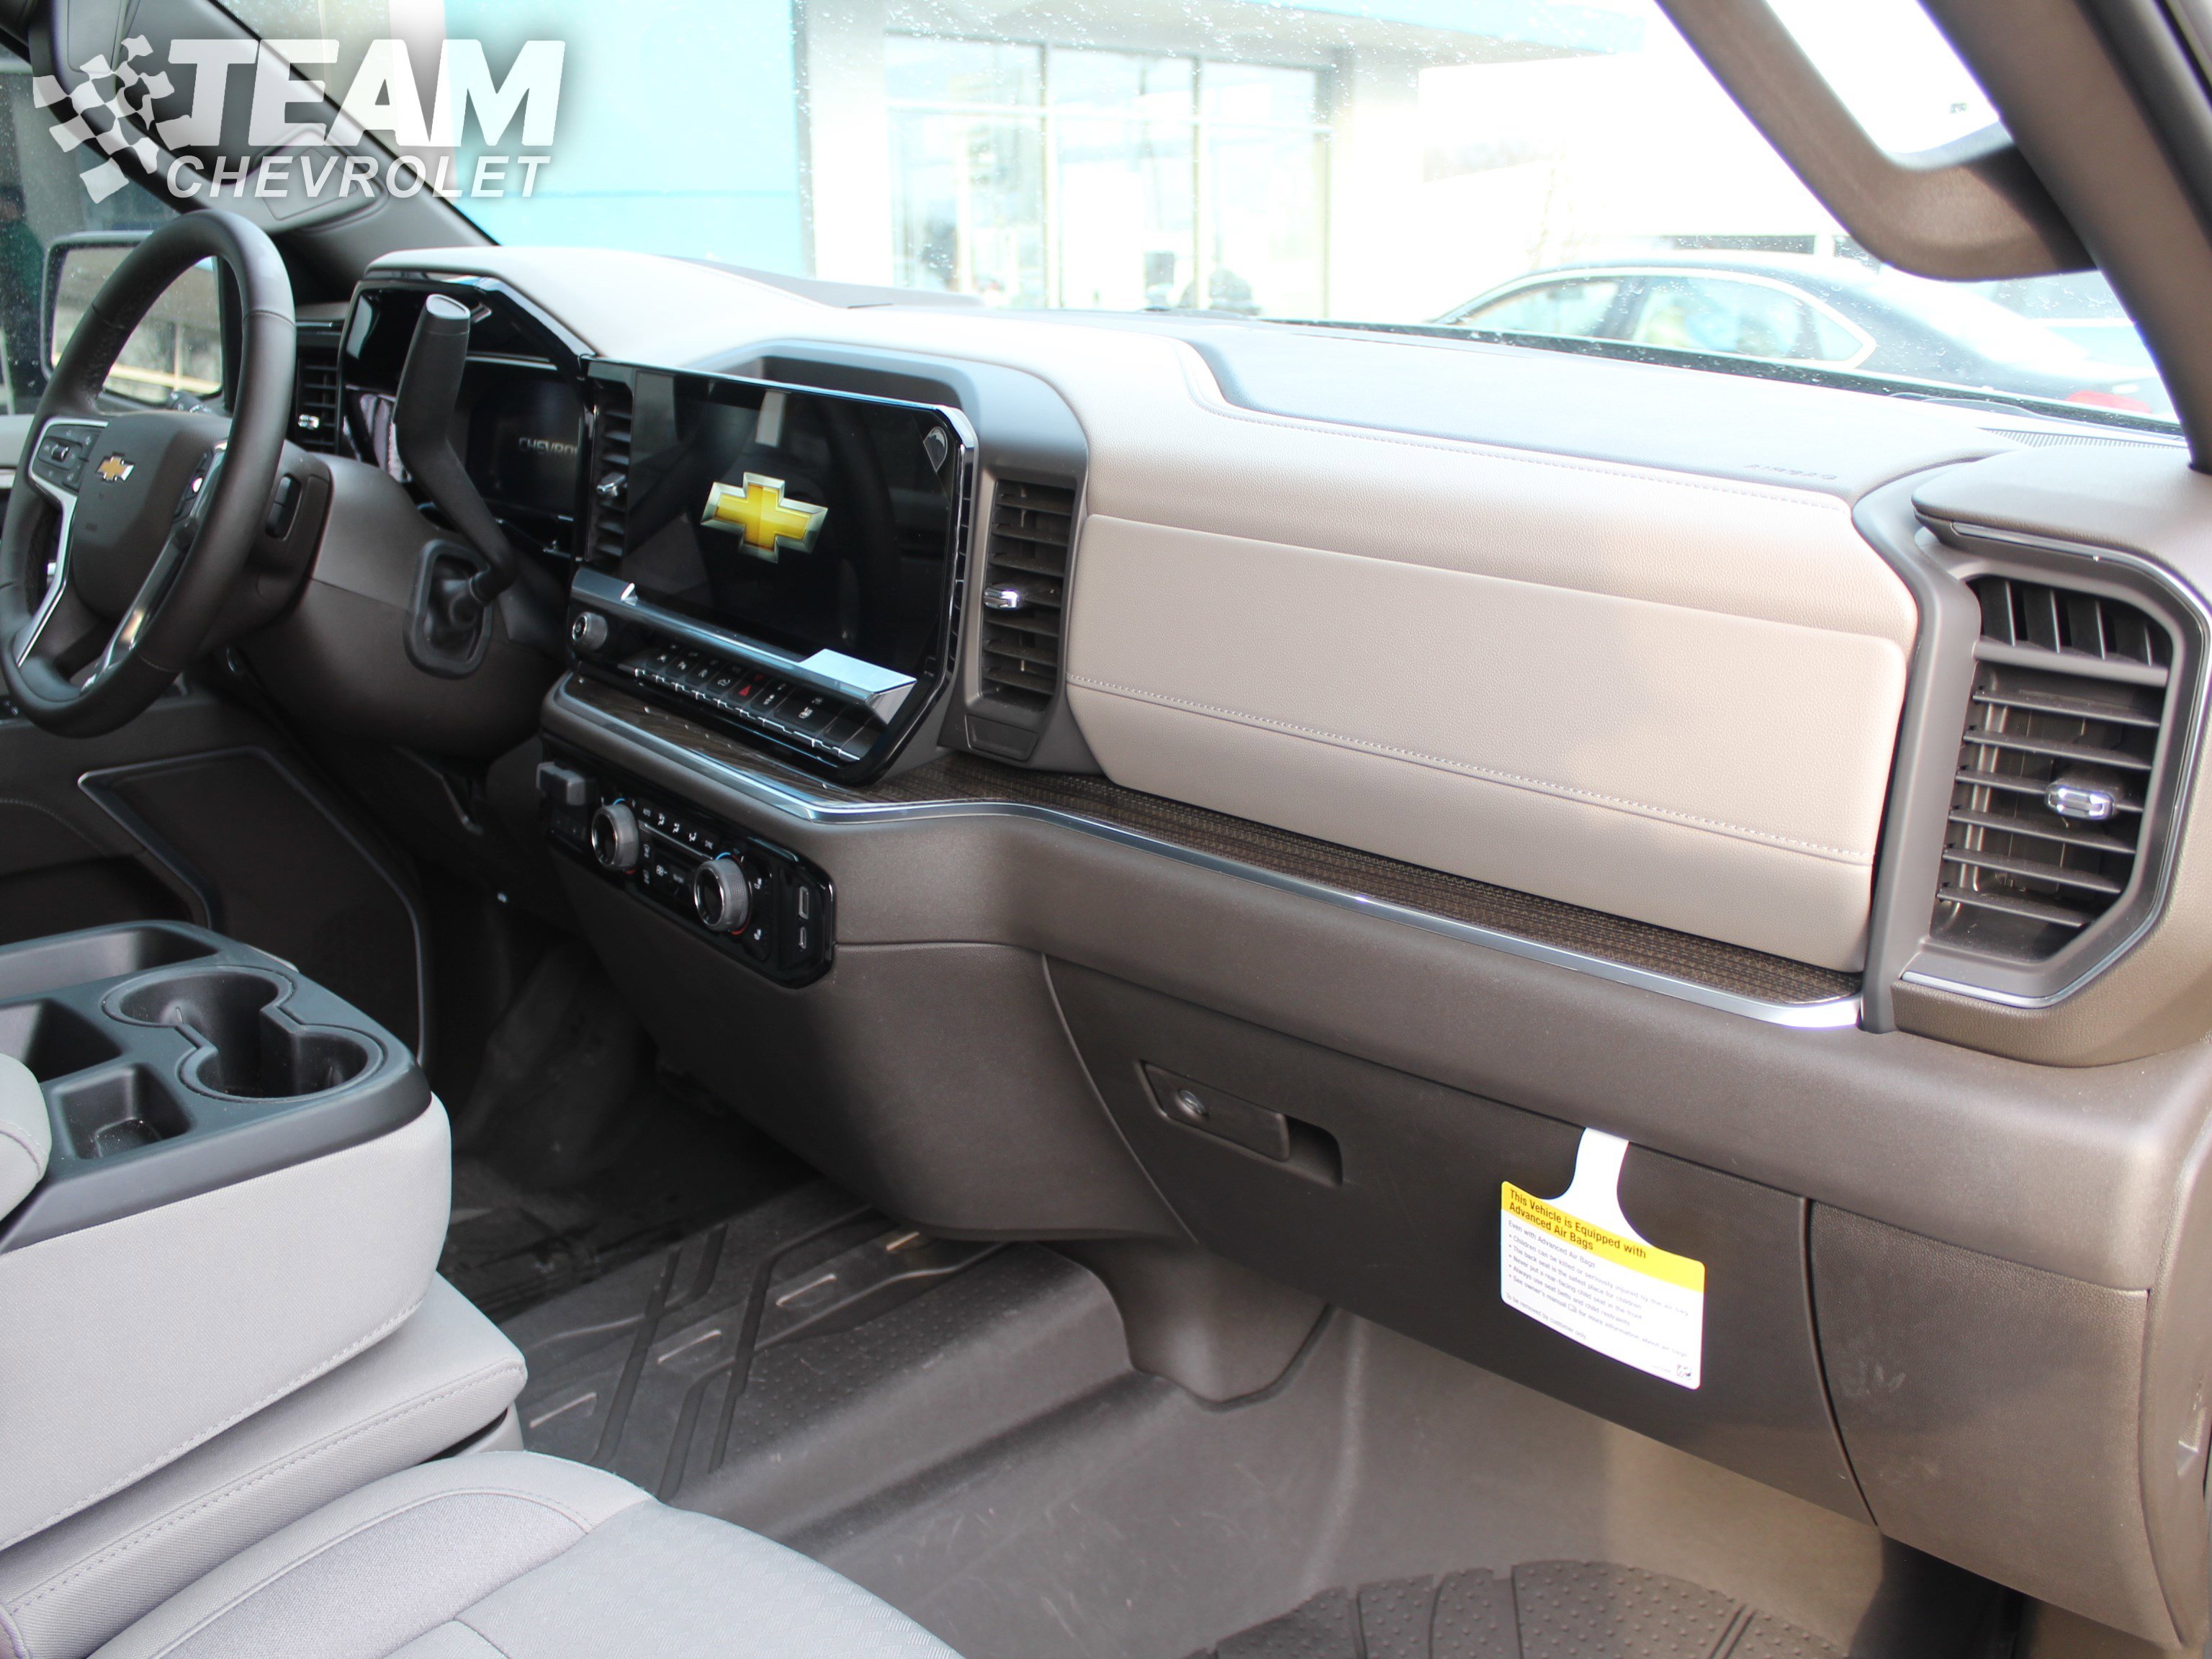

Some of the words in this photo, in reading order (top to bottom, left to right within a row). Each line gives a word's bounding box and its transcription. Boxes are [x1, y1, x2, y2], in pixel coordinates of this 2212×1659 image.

[1743, 464, 1838, 480] AIRBAG
[1509, 1202, 1551, 1231] Advanced
[1554, 1225, 1567, 1238] Air
[1570, 1233, 1593, 1251] Bags
[1509, 1220, 1522, 1233] Even
[1524, 1229, 1537, 1240] with
[1538, 1236, 1567, 1256] Advanced
[1569, 1251, 1578, 1260] Air
[1580, 1256, 1596, 1268] Bags
[1510, 1189, 1527, 1206] This
[1529, 1200, 1561, 1223] Vehicle
[1564, 1217, 1573, 1228] is
[1575, 1222, 1620, 1249] Equipped
[1624, 1243, 1646, 1259] with
[1513, 1266, 1532, 1280] Always
[1534, 1277, 1543, 1286] use
[1513, 1245, 1523, 1255] The
[1524, 1251, 1537, 1262] back
[1539, 1260, 1550, 1269] seat
[1558, 1269, 1567, 1277] the
[1587, 1283, 1604, 1295] place
[1616, 1295, 1642, 1309] children
[1513, 1256, 1528, 1267] Never
[1577, 1289, 1591, 1299] child
[1513, 1275, 1523, 1285] See
[1514, 1235, 1537, 1252] Children
[1538, 1249, 1548, 1259] can
[1550, 1254, 1557, 1263] be
[1559, 1259, 1575, 1272] killed
[1585, 1272, 1613, 1289] seriously
[1615, 1285, 1639, 1298] injured
